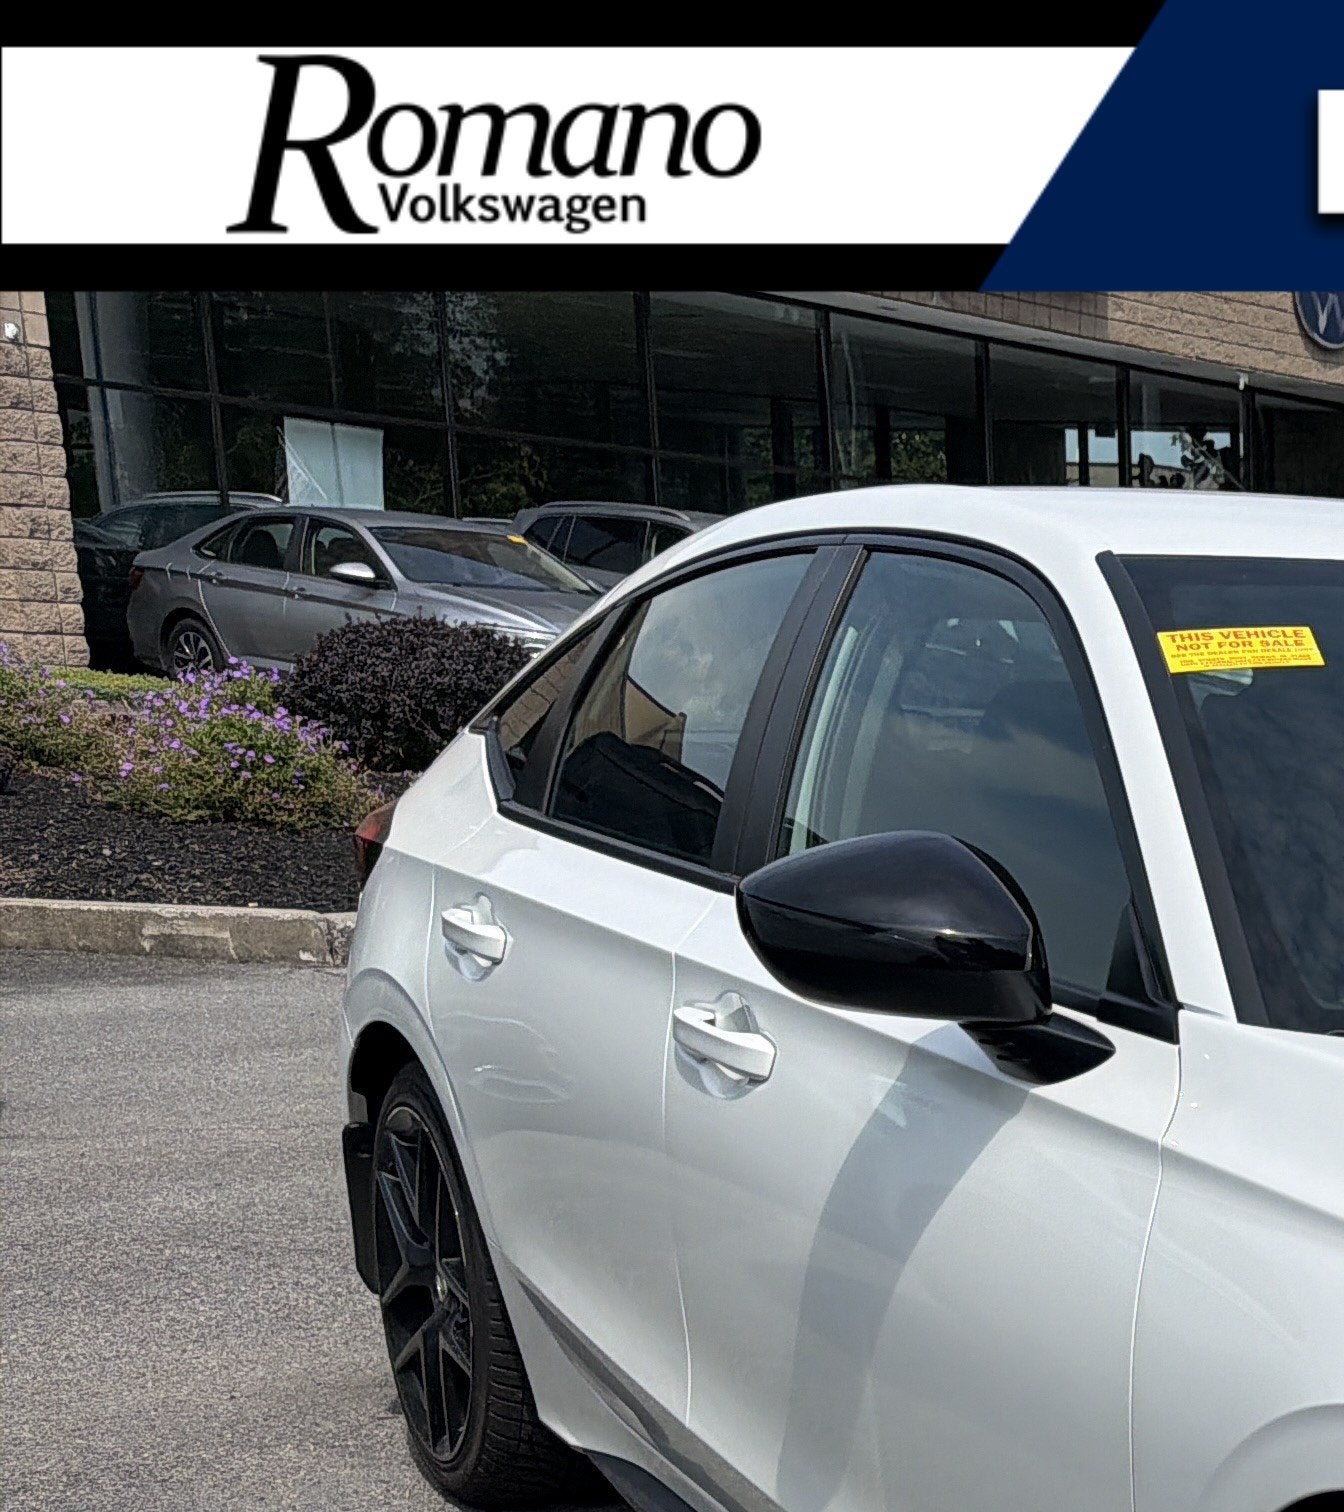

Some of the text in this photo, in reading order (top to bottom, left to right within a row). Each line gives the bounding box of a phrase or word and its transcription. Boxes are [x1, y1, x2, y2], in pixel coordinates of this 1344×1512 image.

[1166, 630, 1307, 643] THIS VEHICLE
[1176, 639, 1306, 651] NOT FOR SALE
